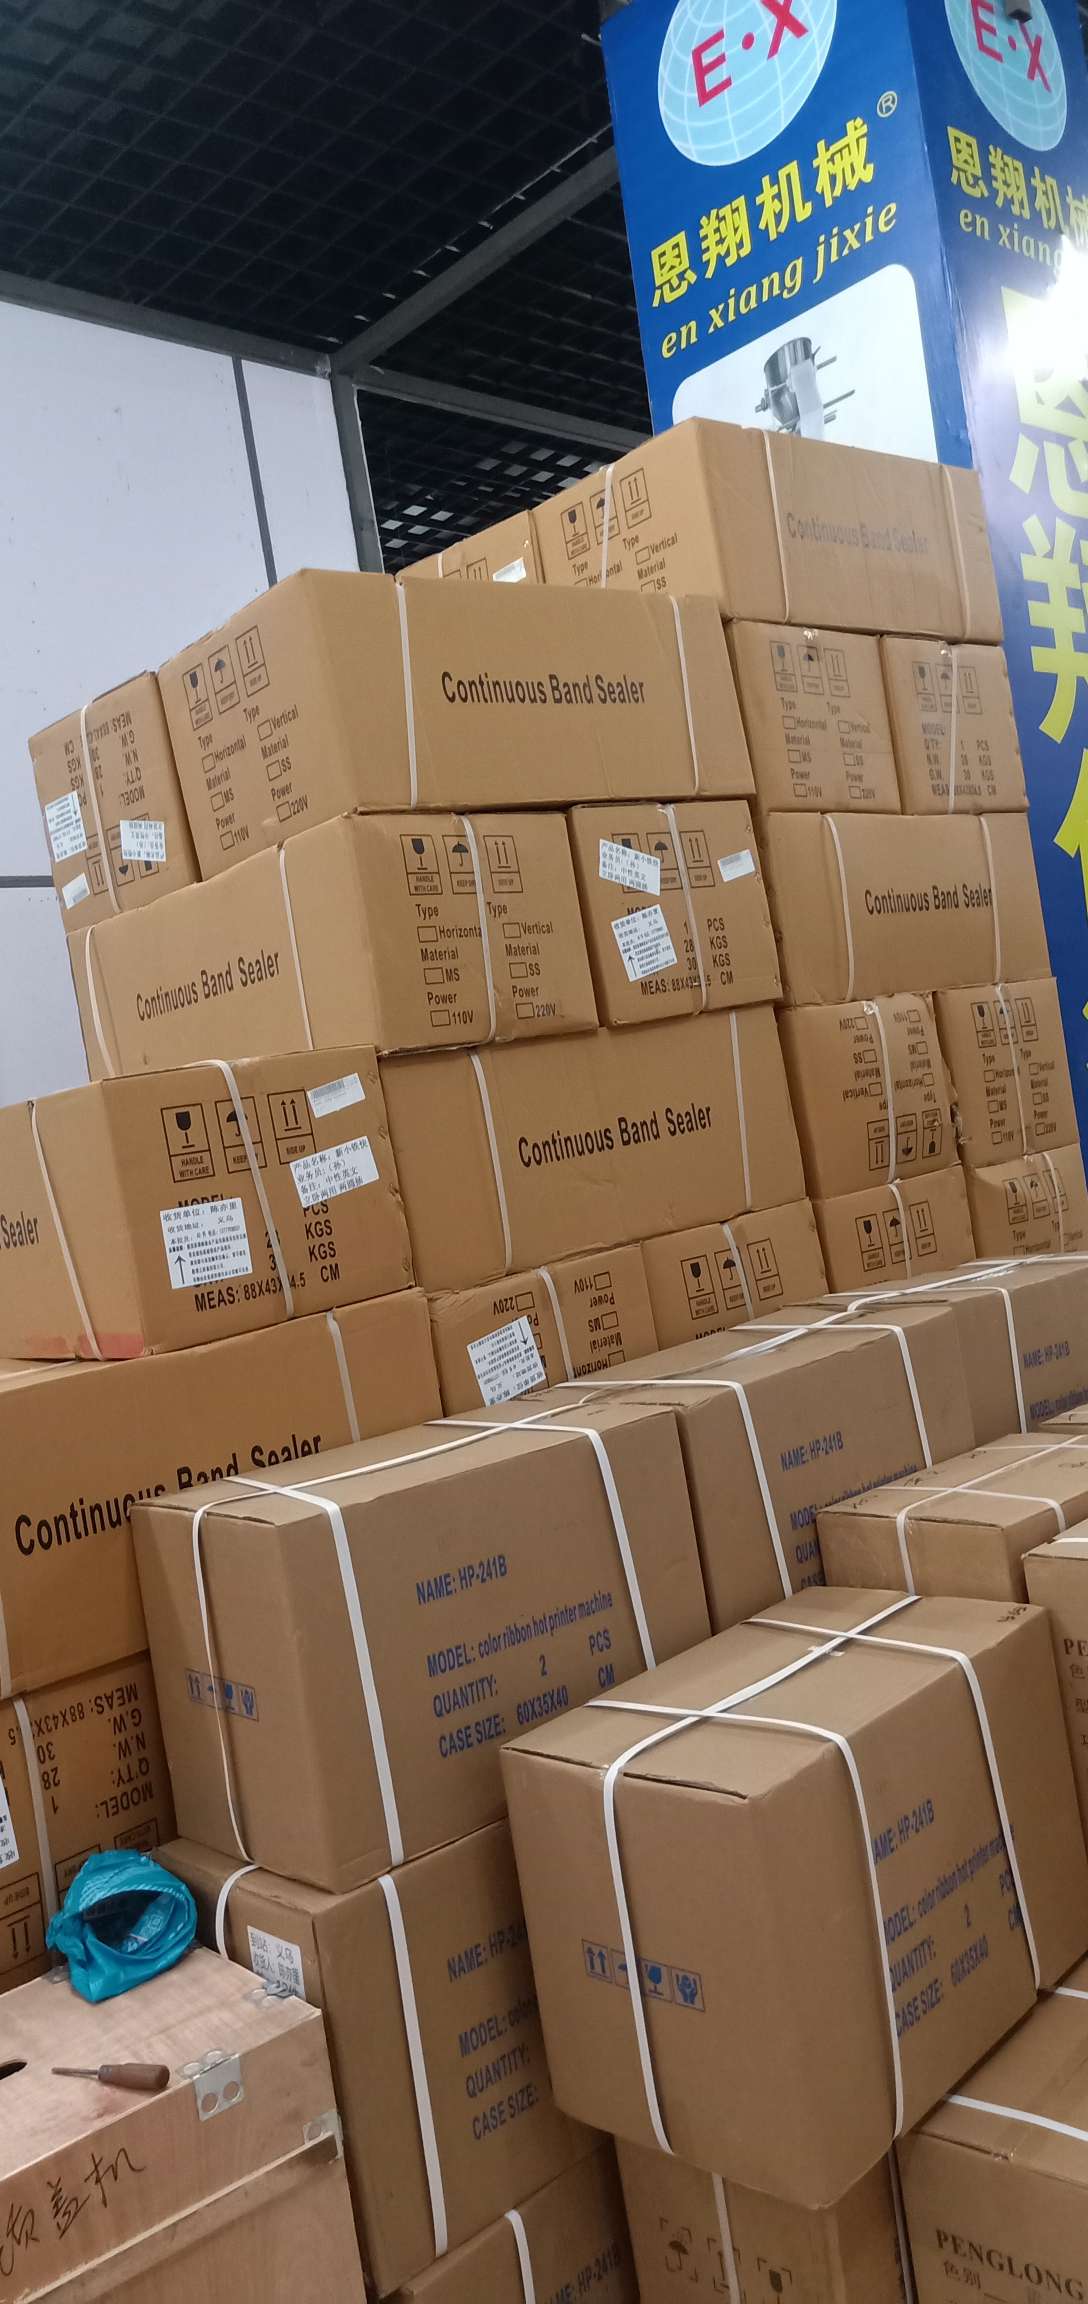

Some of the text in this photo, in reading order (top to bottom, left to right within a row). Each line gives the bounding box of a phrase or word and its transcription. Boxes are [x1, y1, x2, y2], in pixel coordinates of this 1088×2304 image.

[650, 117, 875, 308] 恩翔机械
[959, 208, 991, 241] en
[660, 202, 898, 359] en xiang jixie
[649, 532, 679, 556] Vertical
[636, 557, 667, 582] Material
[440, 670, 646, 705] Continuous Band Sealer
[242, 704, 261, 725] Type
[270, 704, 300, 731] Vertical
[197, 732, 214, 752] Type
[214, 735, 248, 762] Horizontal
[260, 733, 290, 761] Material
[281, 756, 293, 773] SS
[206, 767, 232, 792] Material
[270, 781, 294, 802] Power
[223, 787, 235, 805] MS
[290, 793, 310, 817] 220V
[215, 812, 237, 831] Power
[233, 826, 250, 847] 110V
[486, 901, 509, 920] Type
[865, 881, 993, 916] Continuous Band Sealer
[415, 903, 440, 921] Type
[438, 924, 483, 941] Horizonta
[520, 920, 554, 937] Vertical
[706, 917, 726, 932] PCS
[420, 947, 460, 963] Material
[504, 943, 541, 958] Material
[709, 935, 729, 951] KGS
[528, 962, 542, 977] SS
[712, 952, 732, 969] KGS
[136, 948, 280, 1022] Continuous Band Sealer
[444, 967, 461, 984] MS
[640, 970, 734, 997] MEAS: CM
[427, 991, 458, 1006] Power
[511, 984, 540, 999] Power
[451, 1009, 475, 1026] 110V
[534, 1003, 557, 1018] 220V
[842, 1085, 870, 1102] Vertical
[517, 1102, 712, 1168] Continuous Band Sealer
[181, 1156, 204, 1166] HANDLE
[0, 1210, 39, 1250] Sealer
[304, 1219, 334, 1241] KGS
[308, 1241, 338, 1263] KGS
[194, 1263, 341, 1312] MEAS: CM
[573, 1277, 594, 1295] 110V
[492, 1294, 516, 1316] 220V
[589, 1292, 616, 1308] Power
[587, 1316, 602, 1333] MS
[590, 1331, 623, 1354] Material
[780, 1430, 845, 1473] NAME: HP-241B
[416, 1554, 508, 1605] NAME: HP-241B
[427, 1589, 614, 1678] MODEL: color ribbon hot printer machine
[433, 1628, 613, 1718] QUANTITY: 2 PCS
[89, 1682, 140, 1717] MEAS:
[439, 1663, 616, 1760] CASE SIZE: 60X35X40 CM
[36, 1707, 142, 1765] G.W. 30
[42, 1731, 147, 1790] N.W. 28
[52, 1757, 150, 1816] Q'TY: 1
[95, 1782, 155, 1820] MODEL:
[896, 1797, 936, 1844] HP-241B
[963, 1903, 972, 1929] 2
[447, 1943, 489, 1984] NAME:
[921, 1978, 945, 2016] SIZE:
[950, 1934, 990, 1988] 60X35X40
[458, 2012, 508, 2058] MODEL:
[465, 2042, 532, 2099] QUANTITY:
[471, 2081, 540, 2141] CASE SIZE:
[936, 2227, 1084, 2301] PENGLONG
